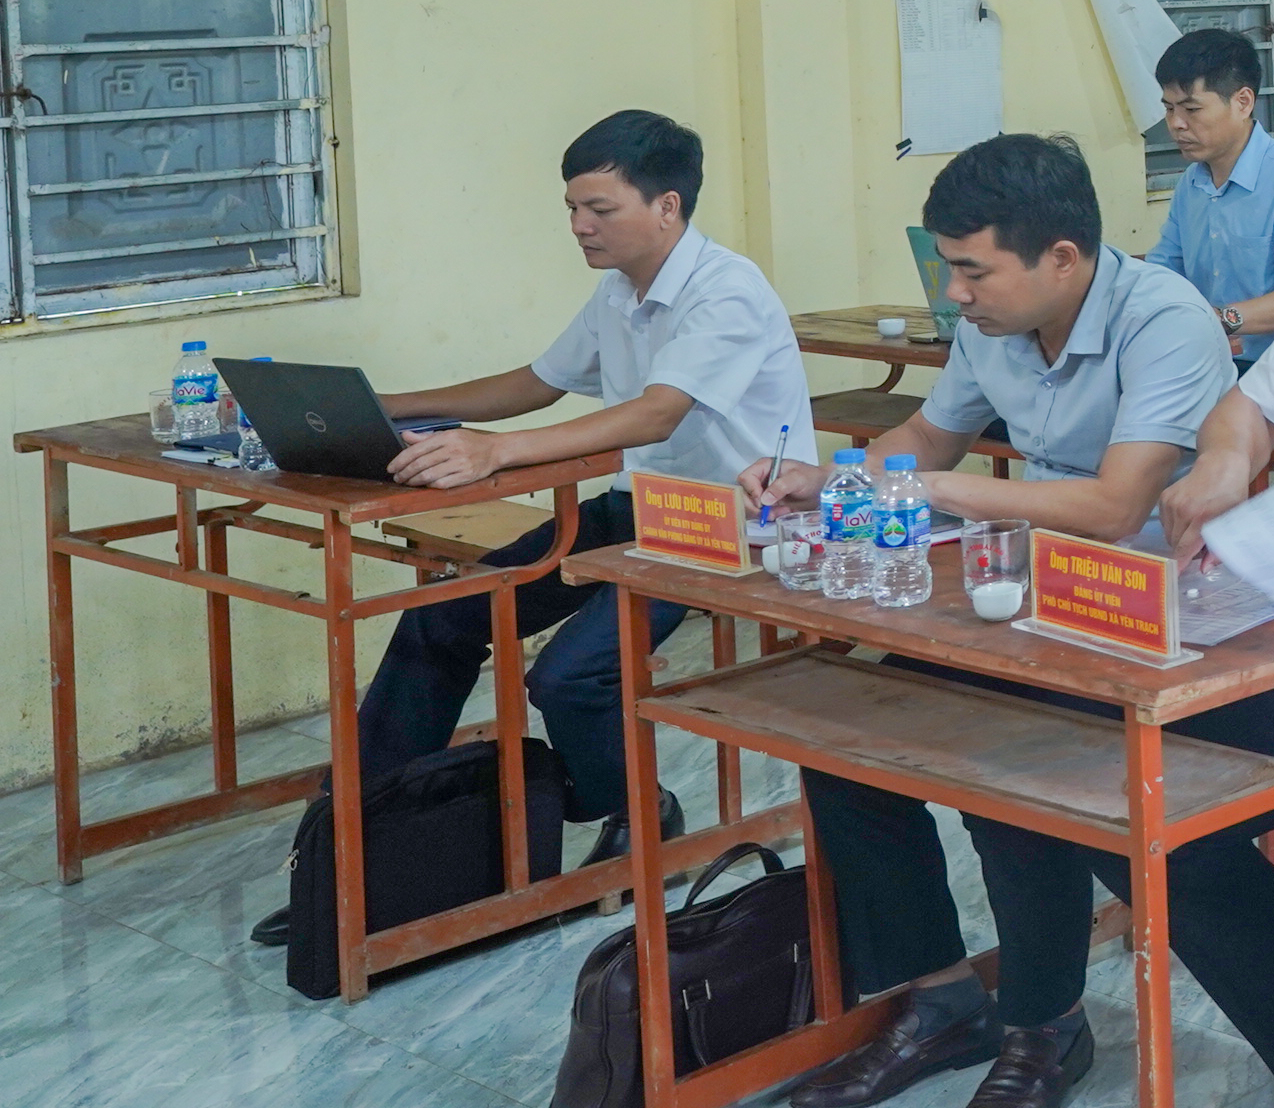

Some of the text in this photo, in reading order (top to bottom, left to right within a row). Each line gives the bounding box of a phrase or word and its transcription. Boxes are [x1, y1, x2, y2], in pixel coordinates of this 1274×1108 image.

[175, 385, 205, 396] laVie
[645, 487, 726, 520] Ông LƯU ĐỨC HIỆU
[844, 510, 873, 527] laVi
[1049, 547, 1147, 592] Ông TRIỆU VĂN SƠN
[1073, 584, 1121, 607] ĐẢNG ỦY VIÊN
[1042, 594, 1159, 635] PHÓ CHỦ TỊCH UBND XÃ YÊN TRẠCH
